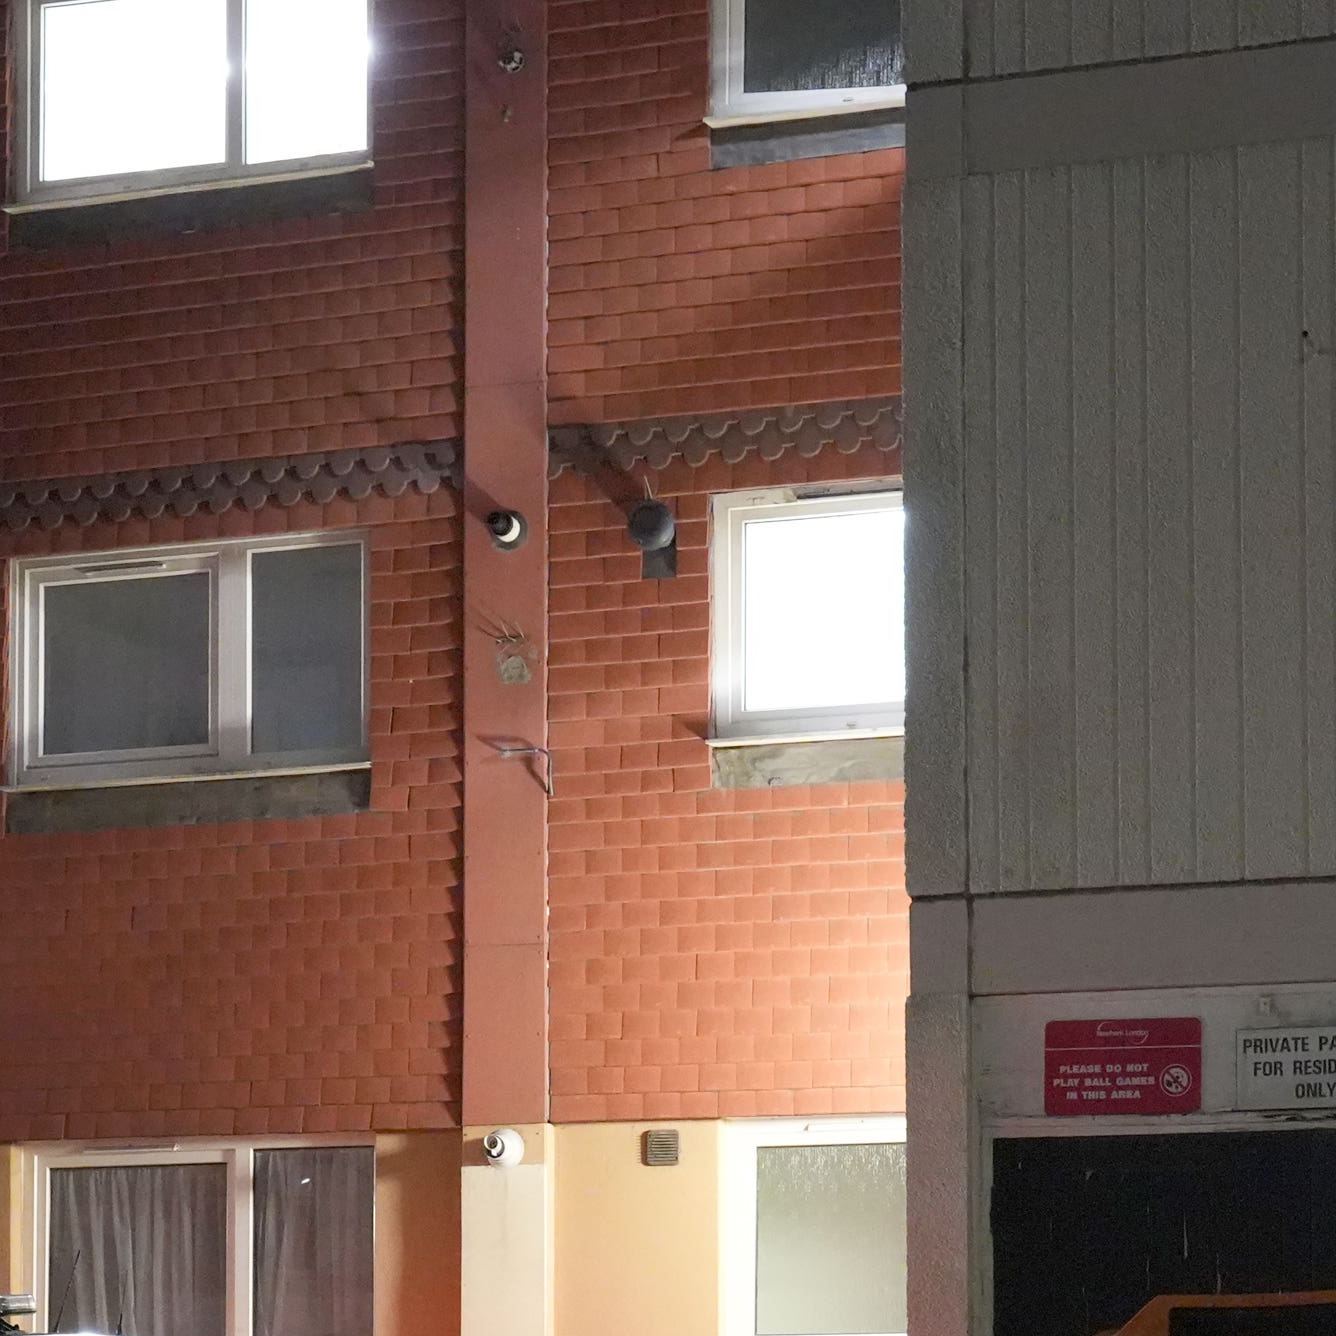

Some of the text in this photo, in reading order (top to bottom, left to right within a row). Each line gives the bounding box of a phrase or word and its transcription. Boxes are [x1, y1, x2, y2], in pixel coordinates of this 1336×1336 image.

[1242, 1036, 1309, 1055] PRIVATE
[1059, 1062, 1148, 1074] PLEASE DO NOT
[1253, 1061, 1284, 1077] FOR
[1053, 1076, 1155, 1087] PLAY BALL GAMES
[1066, 1090, 1141, 1100] IN THIS AREA
[1295, 1081, 1336, 1099] ONLY
